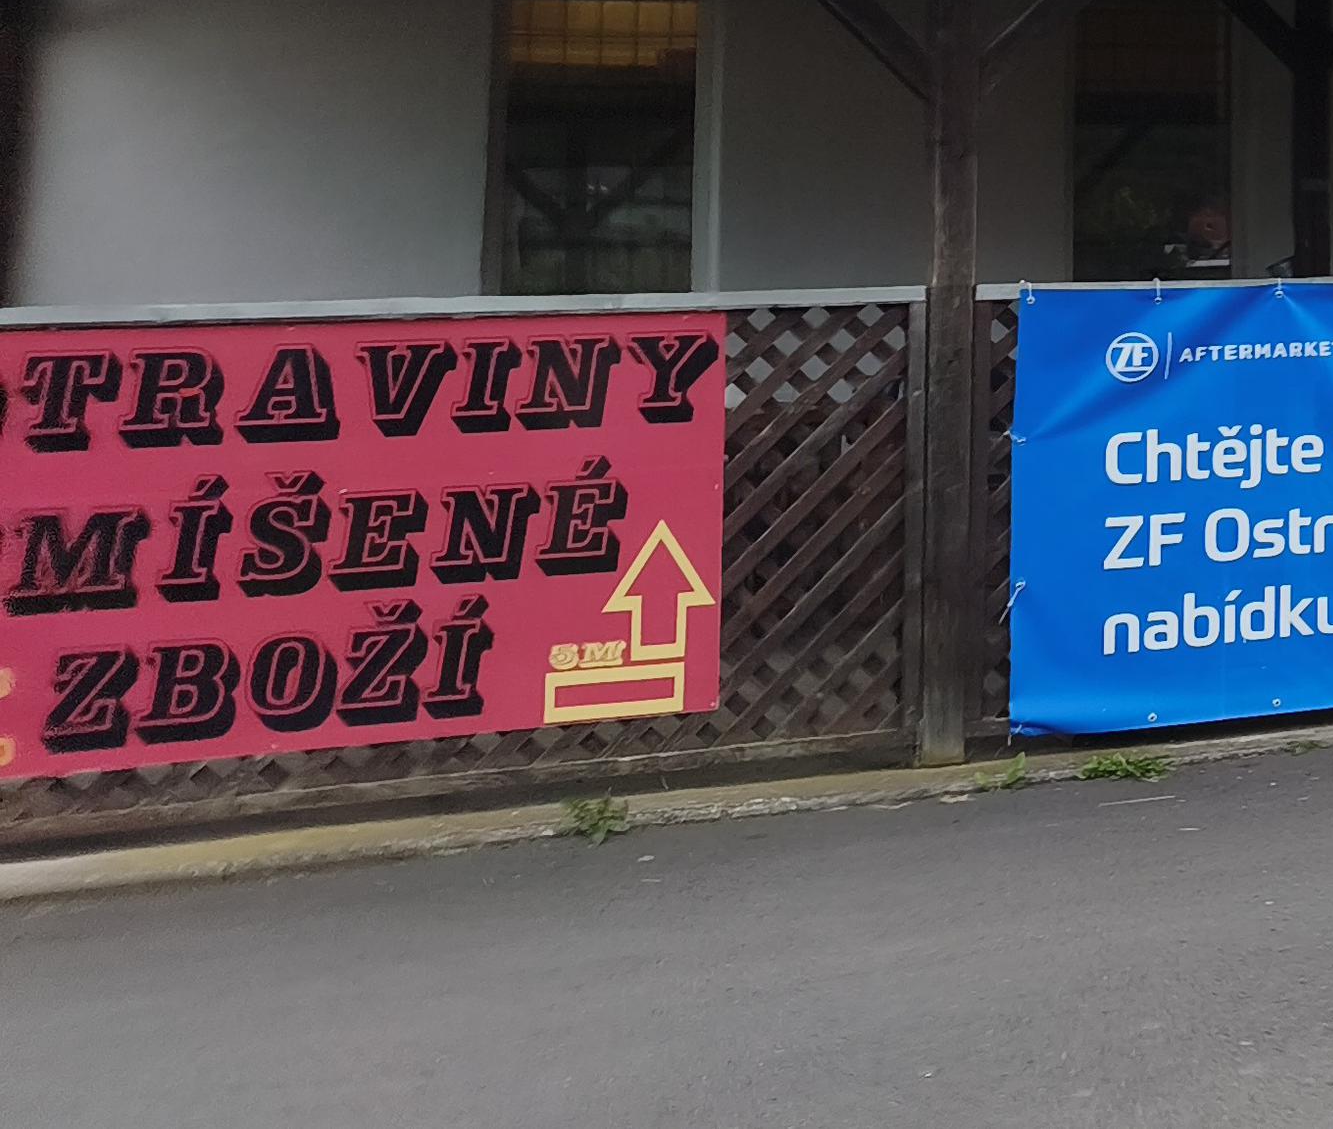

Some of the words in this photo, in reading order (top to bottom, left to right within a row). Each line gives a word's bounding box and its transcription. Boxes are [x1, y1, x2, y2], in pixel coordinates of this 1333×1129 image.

[0, 330, 719, 452] TRAVINY
[1108, 336, 1156, 378] ZF
[1105, 423, 1324, 489] Chtějte
[0, 455, 629, 616] MÍŠENÉ
[1103, 512, 1186, 570] ZF
[41, 594, 495, 755] ZBOŽÍ
